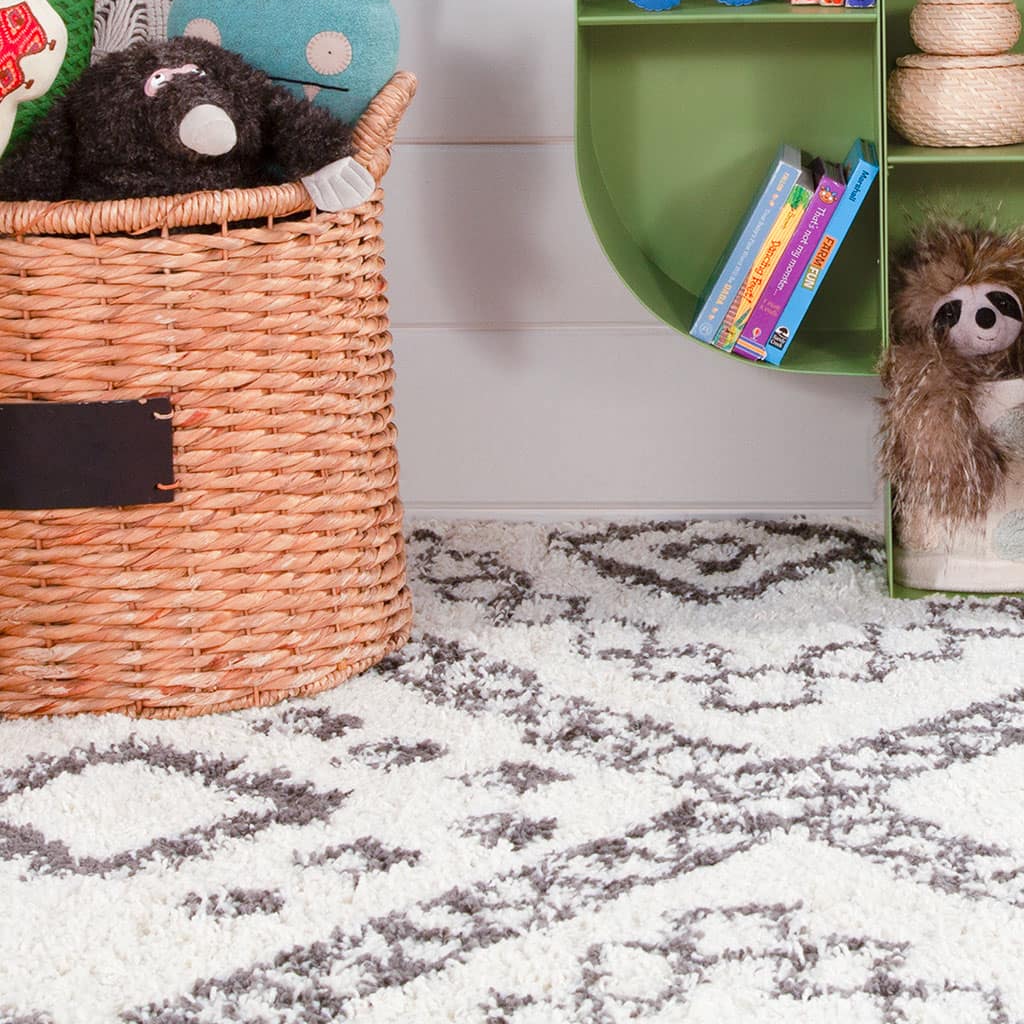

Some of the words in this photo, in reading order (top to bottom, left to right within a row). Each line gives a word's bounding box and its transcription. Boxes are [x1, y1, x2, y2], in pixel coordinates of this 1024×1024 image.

[847, 169, 869, 202] Marshall
[807, 204, 827, 231] That's
[790, 243, 804, 258] my
[800, 229, 812, 245] not
[753, 237, 781, 277] Dancing
[812, 235, 835, 268] FARM
[741, 275, 762, 303] Feet!
[801, 265, 821, 290] FUN
